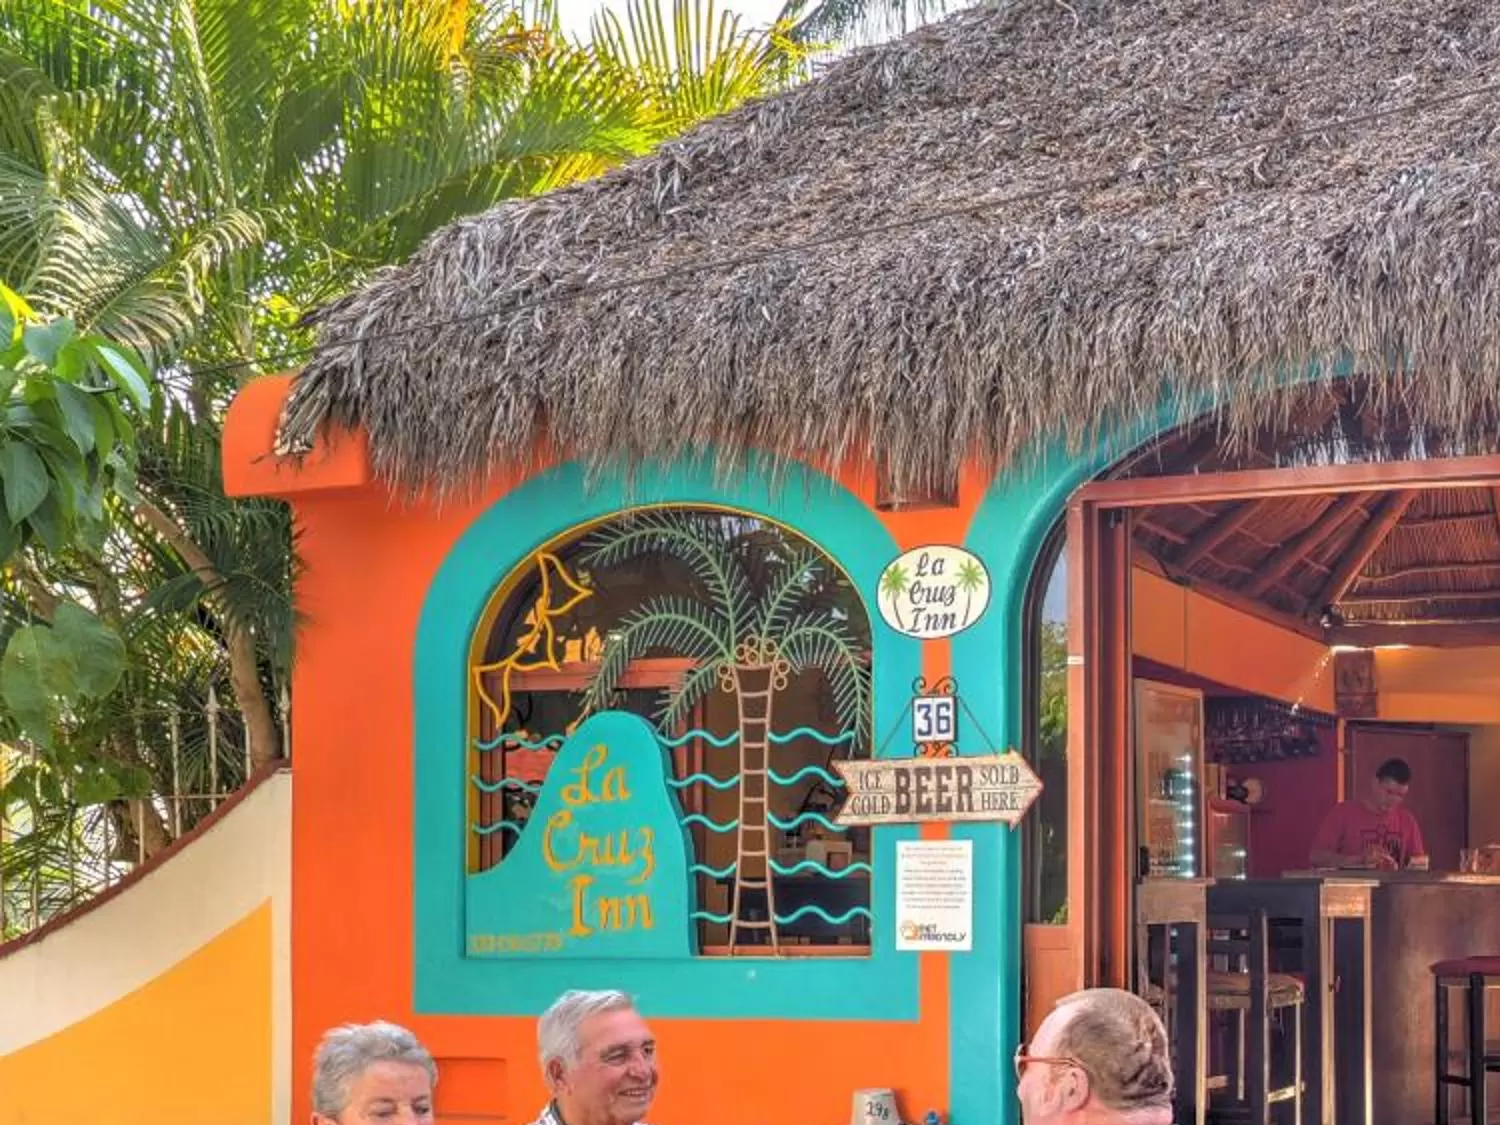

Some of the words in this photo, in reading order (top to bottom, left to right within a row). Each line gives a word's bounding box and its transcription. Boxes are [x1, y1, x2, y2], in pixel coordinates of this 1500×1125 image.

[915, 551, 945, 577] La
[907, 607, 957, 633] Inn
[917, 702, 952, 737] 36
[561, 743, 632, 806] La
[859, 769, 884, 791] ICE
[979, 764, 1020, 786] SOLD
[893, 765, 975, 814] BEER
[980, 791, 1020, 811] HERE
[851, 793, 892, 815] COLD
[543, 810, 656, 885] Cruz
[568, 873, 655, 937] Inn
